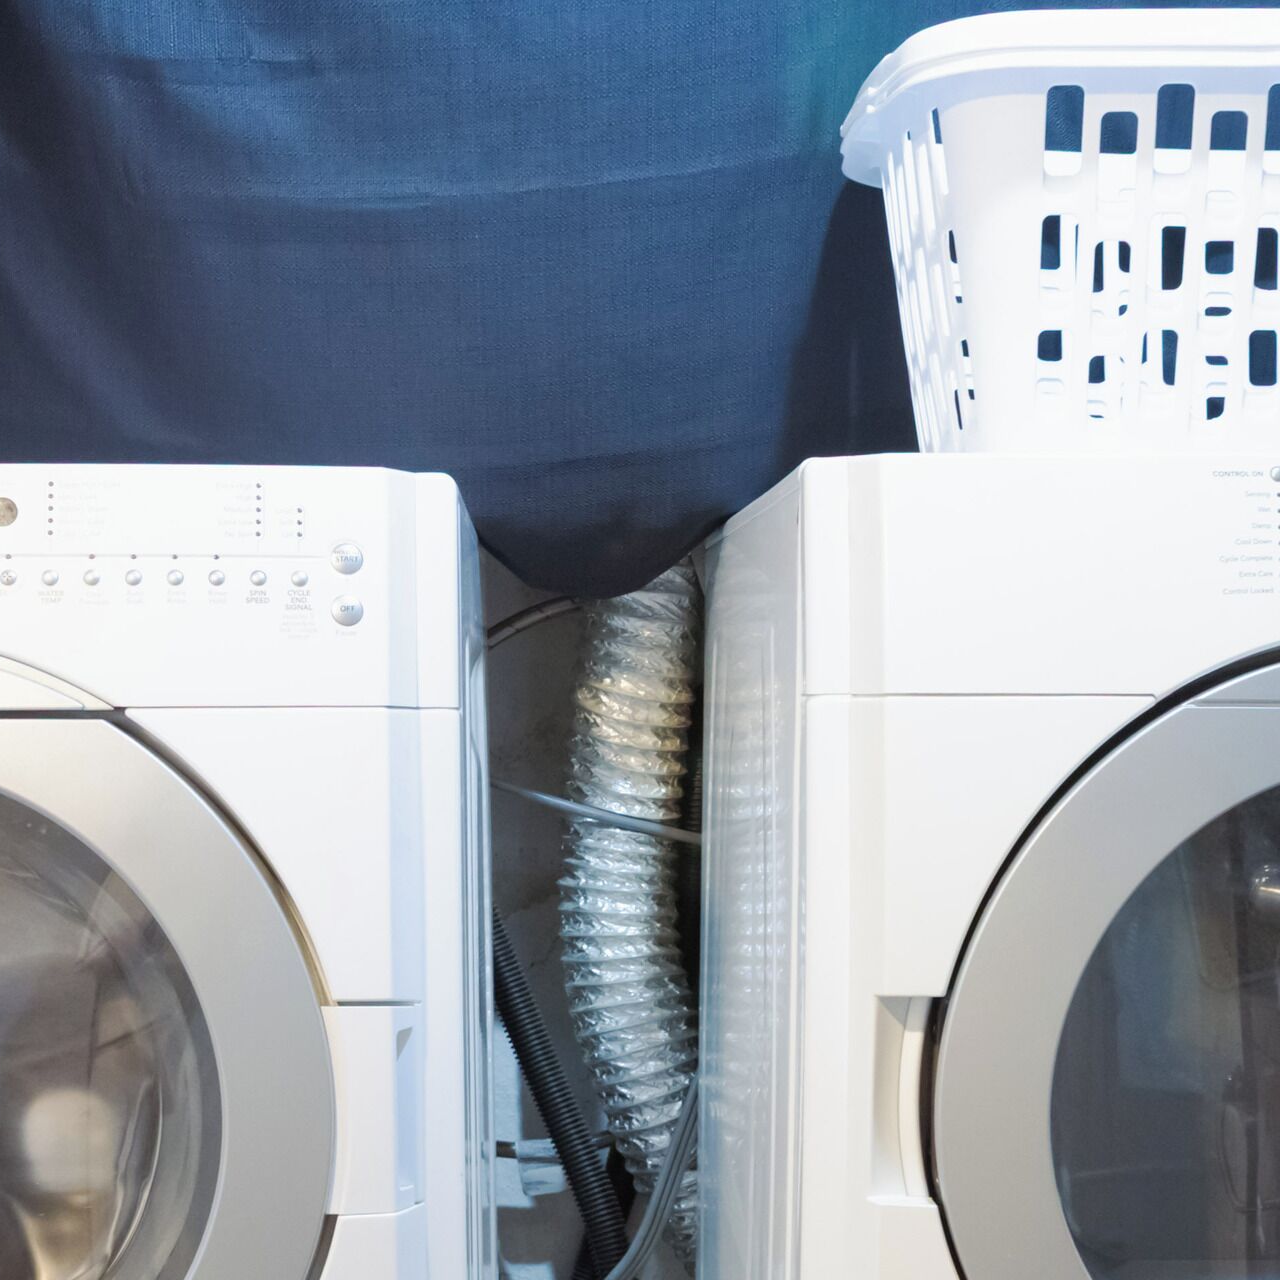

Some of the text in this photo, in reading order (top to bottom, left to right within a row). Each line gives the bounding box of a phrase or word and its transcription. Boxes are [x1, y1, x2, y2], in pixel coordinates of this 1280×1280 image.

[1212, 470, 1248, 478] CONTROL
[336, 555, 359, 563] START
[245, 597, 271, 605] SPEED
[339, 605, 355, 613] OFF
